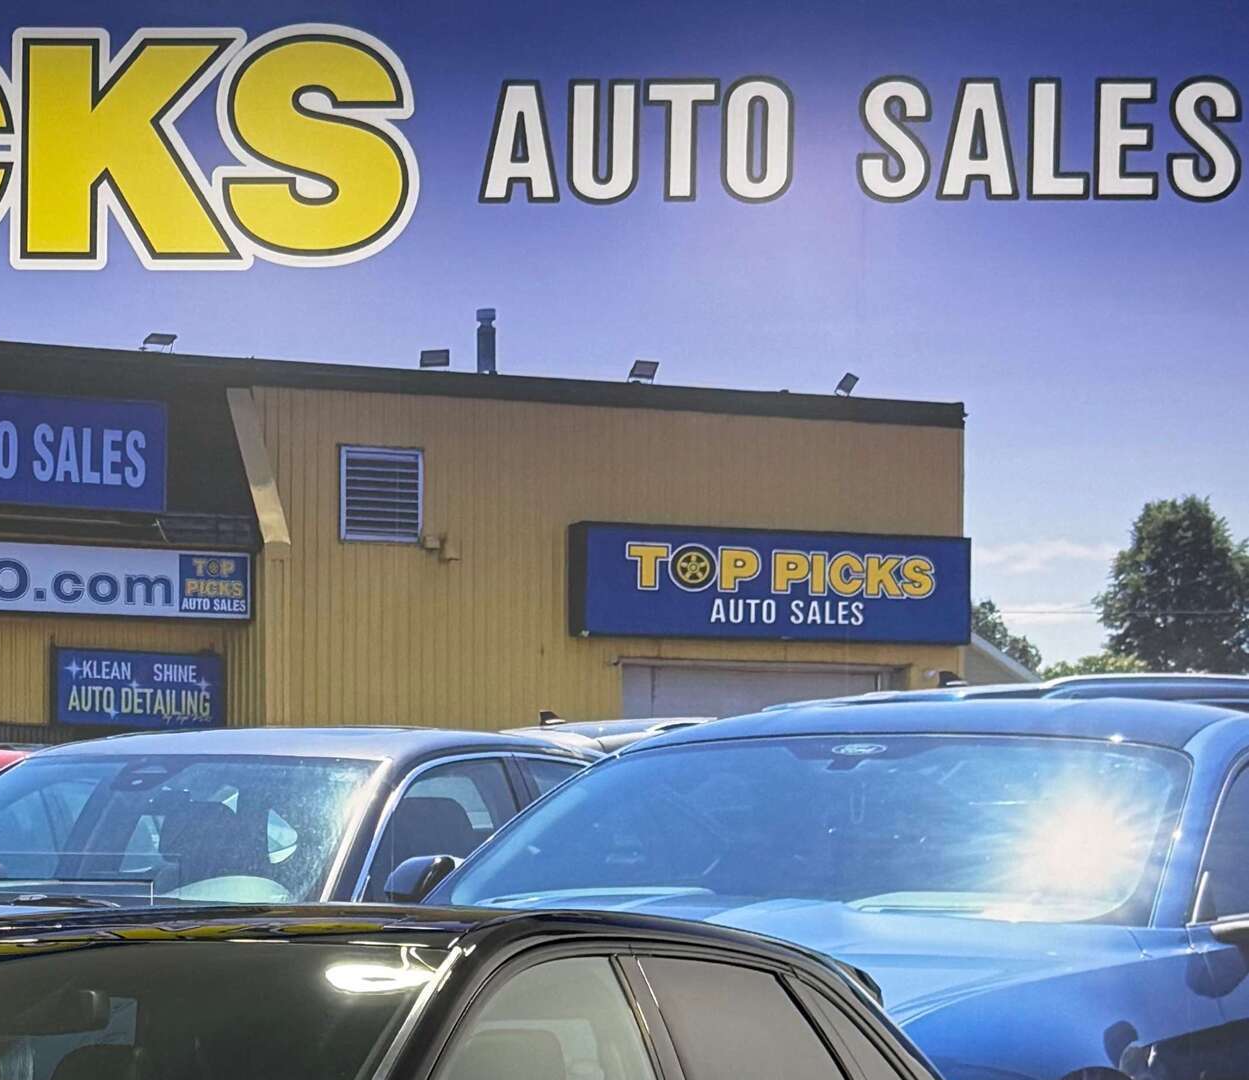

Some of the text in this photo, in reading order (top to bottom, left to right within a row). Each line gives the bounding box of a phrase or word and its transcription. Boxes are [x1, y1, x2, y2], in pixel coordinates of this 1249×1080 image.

[478, 75, 794, 204] AUTO
[857, 74, 1242, 204] SALES
[32, 424, 147, 487] SALES
[184, 557, 244, 598] TOP PICKS
[625, 541, 936, 599] TOP PICKS
[181, 597, 246, 612] AUTO SALES
[710, 598, 865, 626] AUTO SALES
[82, 660, 197, 683] KLEAN SHINE
[68, 685, 211, 717] AUTO DETAILING
